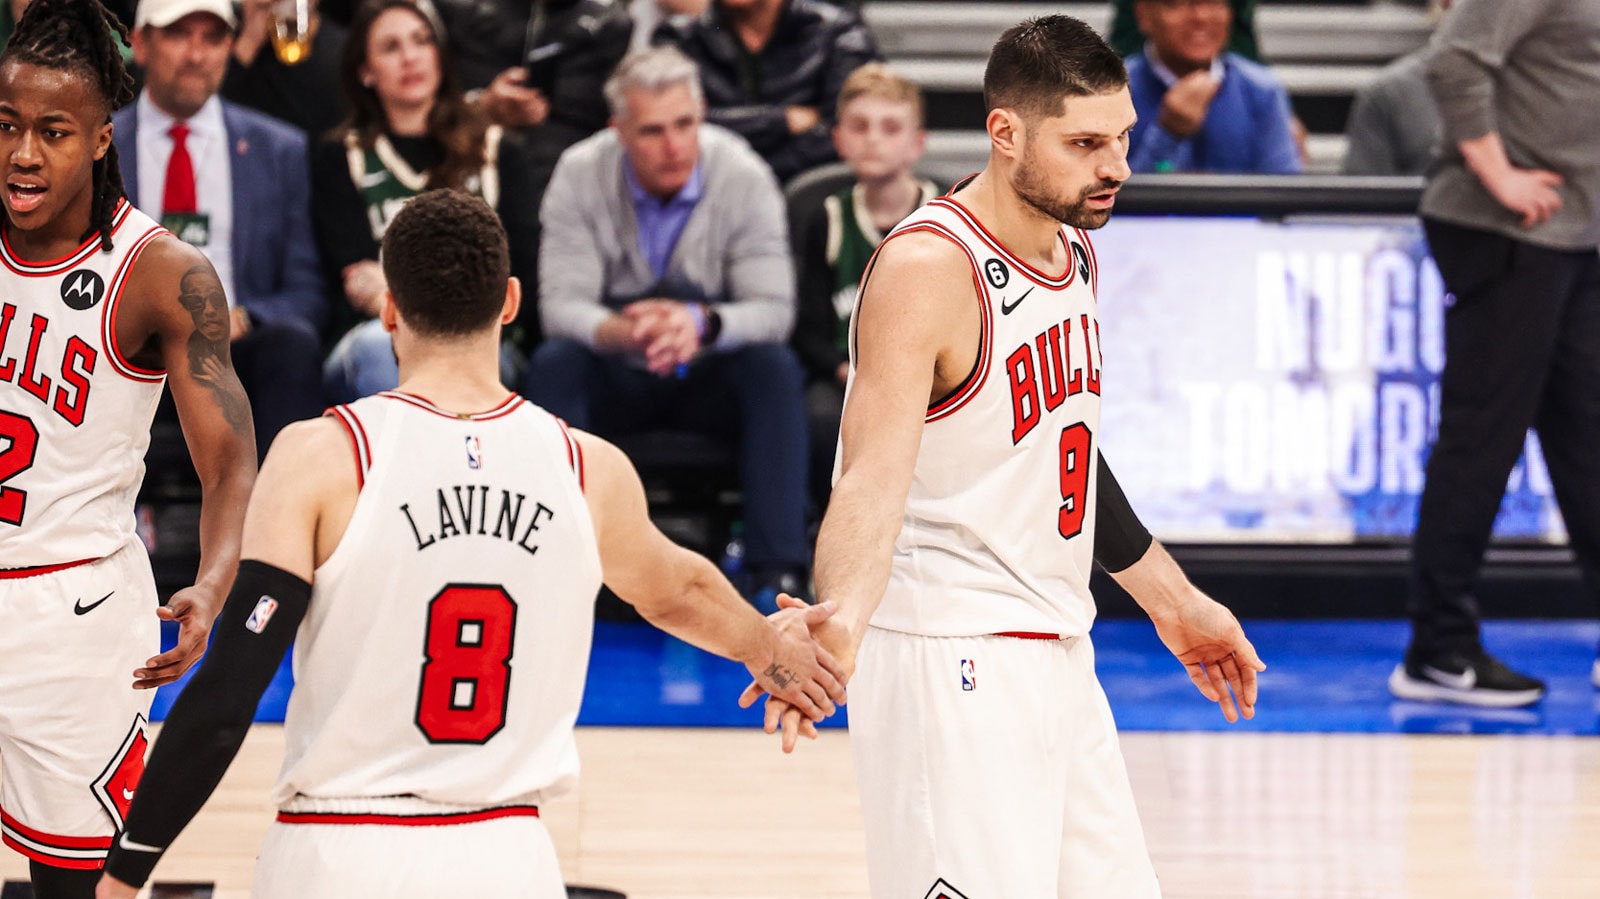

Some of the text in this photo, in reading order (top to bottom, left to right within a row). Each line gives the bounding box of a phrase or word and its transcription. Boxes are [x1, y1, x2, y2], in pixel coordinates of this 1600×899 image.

[987, 261, 1006, 286] 6
[1005, 313, 1101, 447] BULL
[1179, 380, 1442, 495] TOMOR
[399, 485, 554, 555] LAVINE
[1058, 421, 1092, 541] 9
[413, 582, 518, 746] 8
